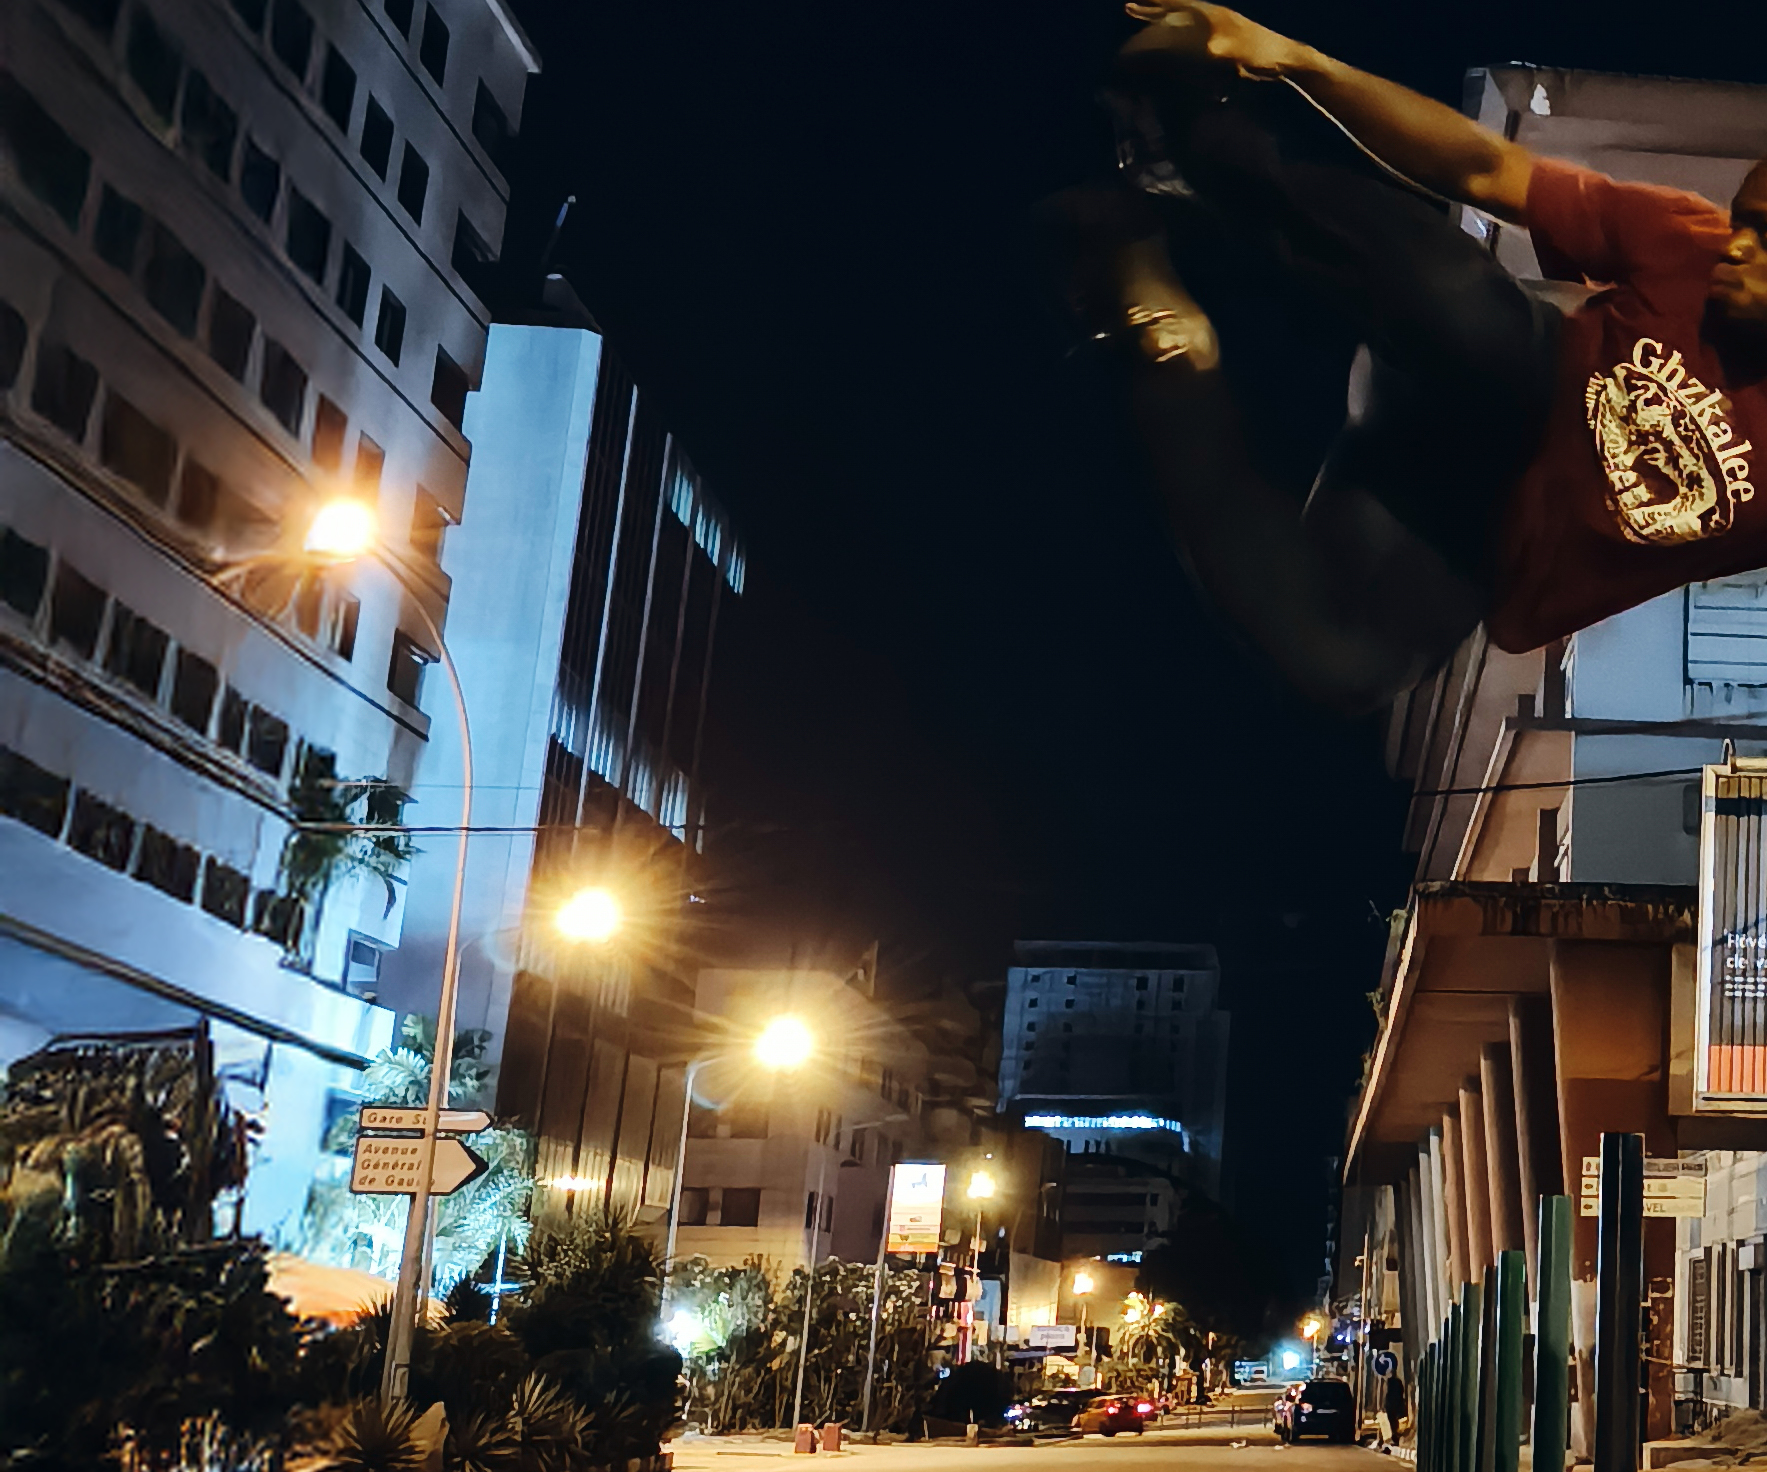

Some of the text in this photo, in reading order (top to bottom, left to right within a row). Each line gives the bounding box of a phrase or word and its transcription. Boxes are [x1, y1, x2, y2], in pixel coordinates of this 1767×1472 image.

[1632, 337, 1755, 503] Ghzkalee
[367, 1112, 403, 1124] Gare
[362, 1143, 418, 1155] Avenue
[361, 1158, 423, 1171] Général
[358, 1174, 377, 1186] de
